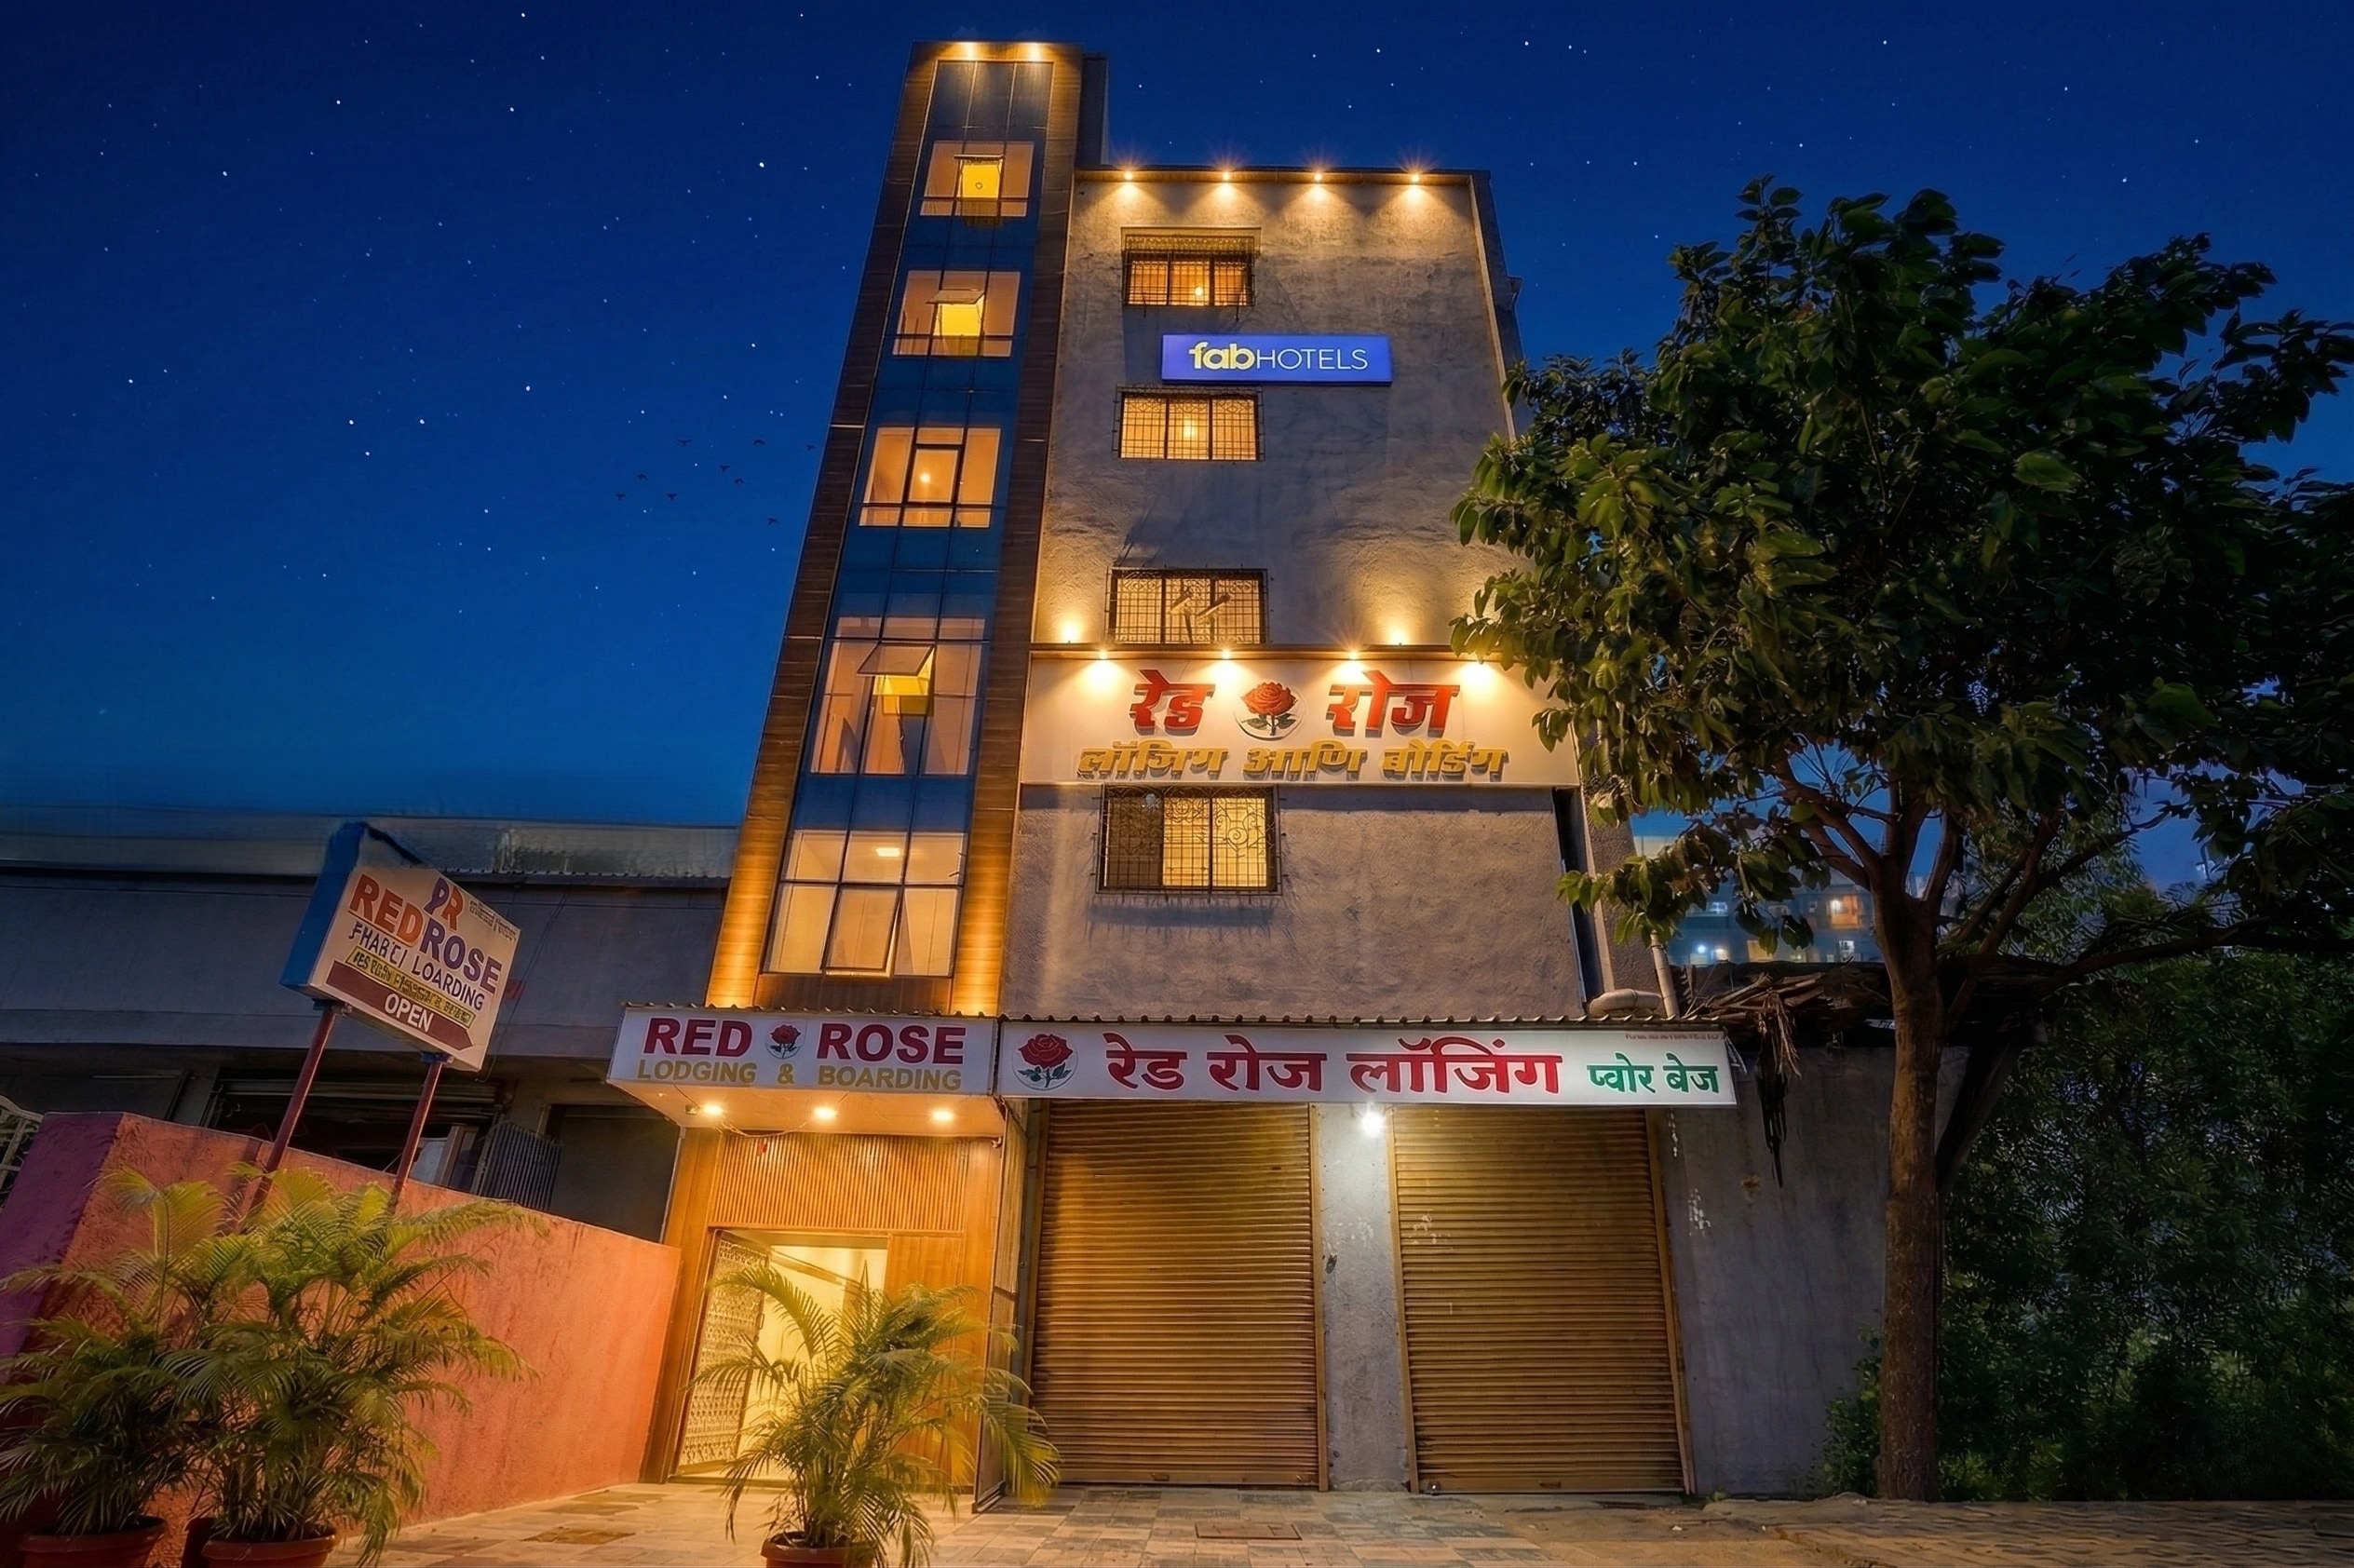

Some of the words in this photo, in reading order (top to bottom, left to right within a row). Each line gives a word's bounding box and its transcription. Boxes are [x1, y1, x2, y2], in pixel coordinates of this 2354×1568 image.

[1188, 342, 1369, 371] fabHOTELS
[1130, 669, 1215, 734] रेड
[1327, 669, 1460, 736] रोज
[1242, 739, 1367, 777] आणि
[384, 993, 435, 1033] OPEN
[643, 1017, 752, 1059] RED
[816, 1021, 967, 1065] ROSE
[637, 1058, 757, 1084] LODGING
[776, 1062, 795, 1086] &
[818, 1064, 962, 1091] BOARDING
[1102, 1032, 1188, 1090] रेड
[1206, 1034, 1328, 1092] रोज
[1346, 1036, 1563, 1095] लॉजिंग
[1662, 1051, 1719, 1094] बेज
